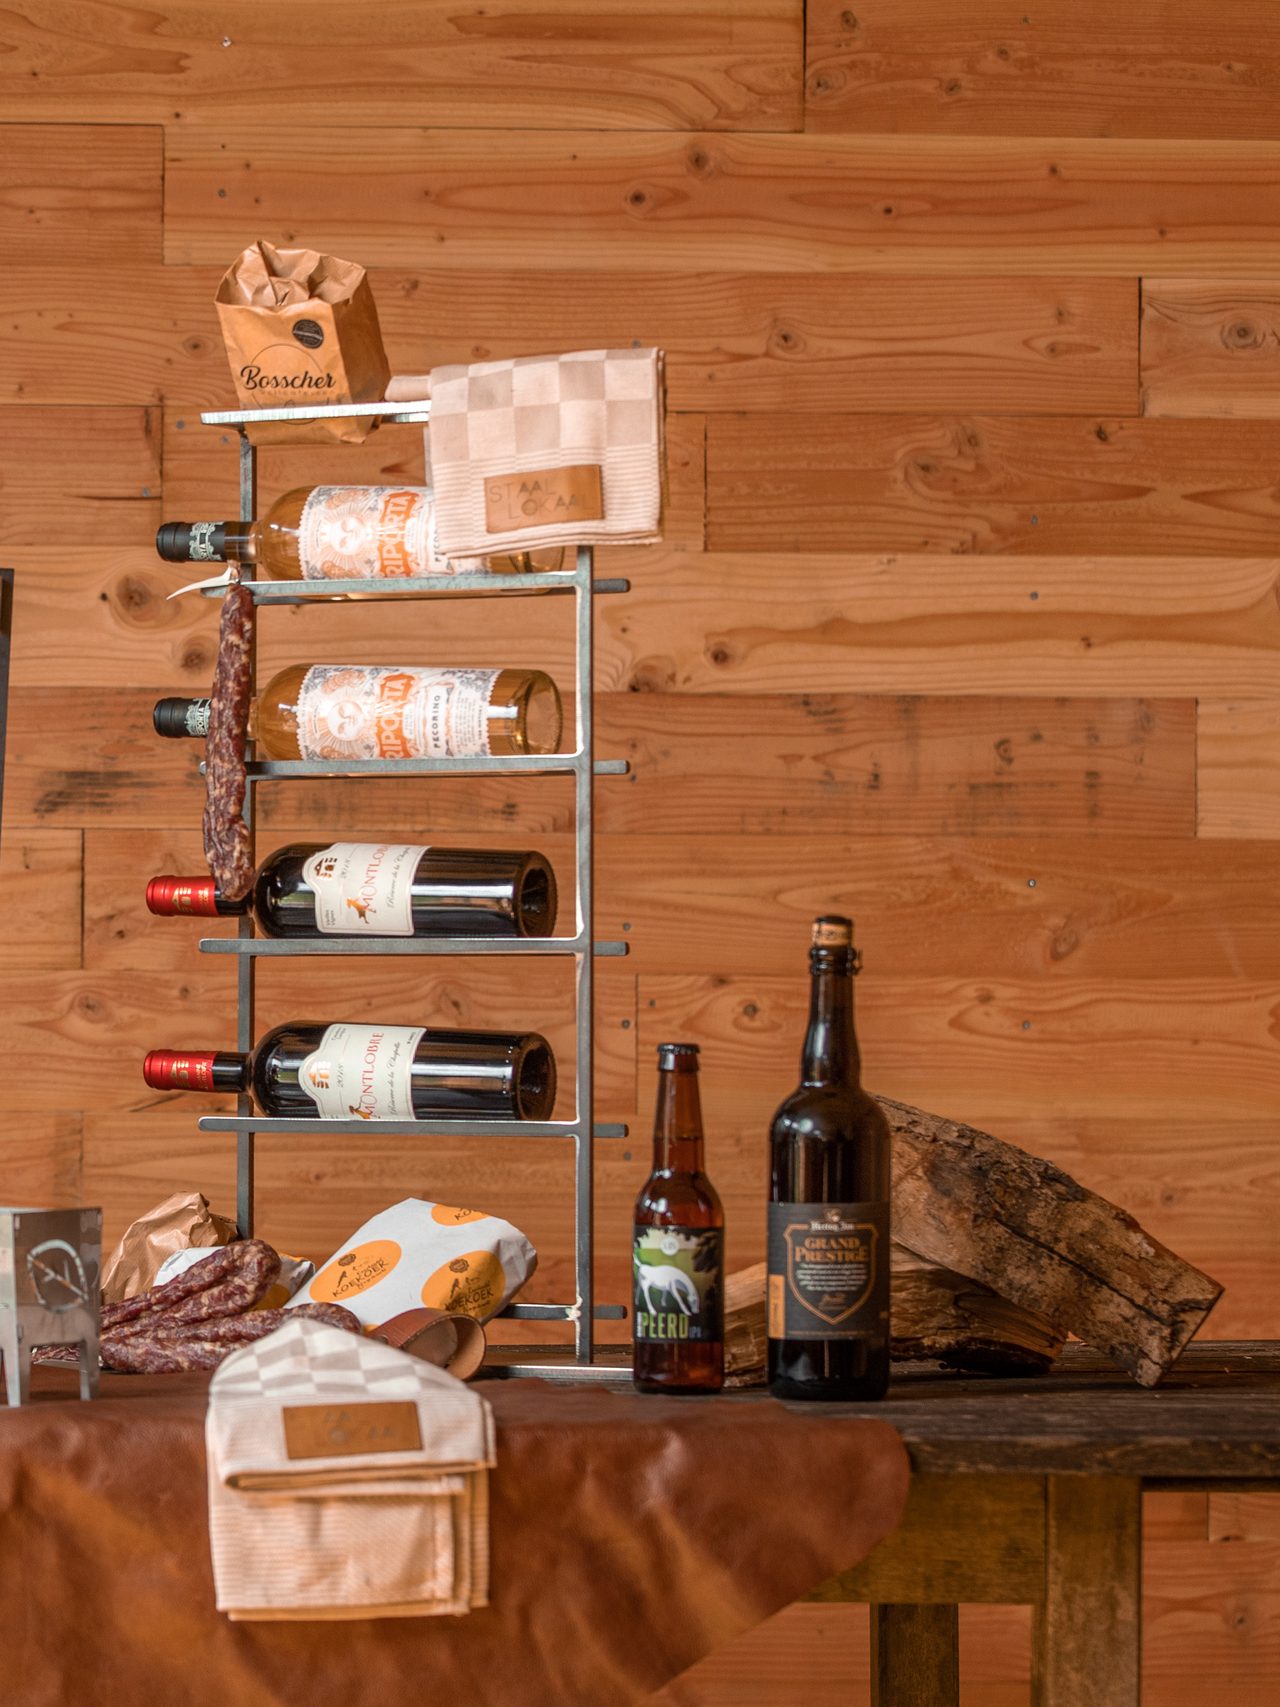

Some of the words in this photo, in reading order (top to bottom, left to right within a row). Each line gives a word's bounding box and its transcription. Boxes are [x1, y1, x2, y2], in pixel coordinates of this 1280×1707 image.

[240, 365, 337, 390] Bosscher
[489, 479, 556, 503] STAAL
[509, 493, 596, 519] LOKAAL
[430, 694, 441, 749] PECORINO
[360, 1032, 384, 1116] MONTLOBRE
[795, 1247, 868, 1263] PRESTIGE
[804, 1237, 861, 1249] GRAND
[332, 1260, 389, 1297] KOEKOEK
[641, 1312, 689, 1339] PEERD
